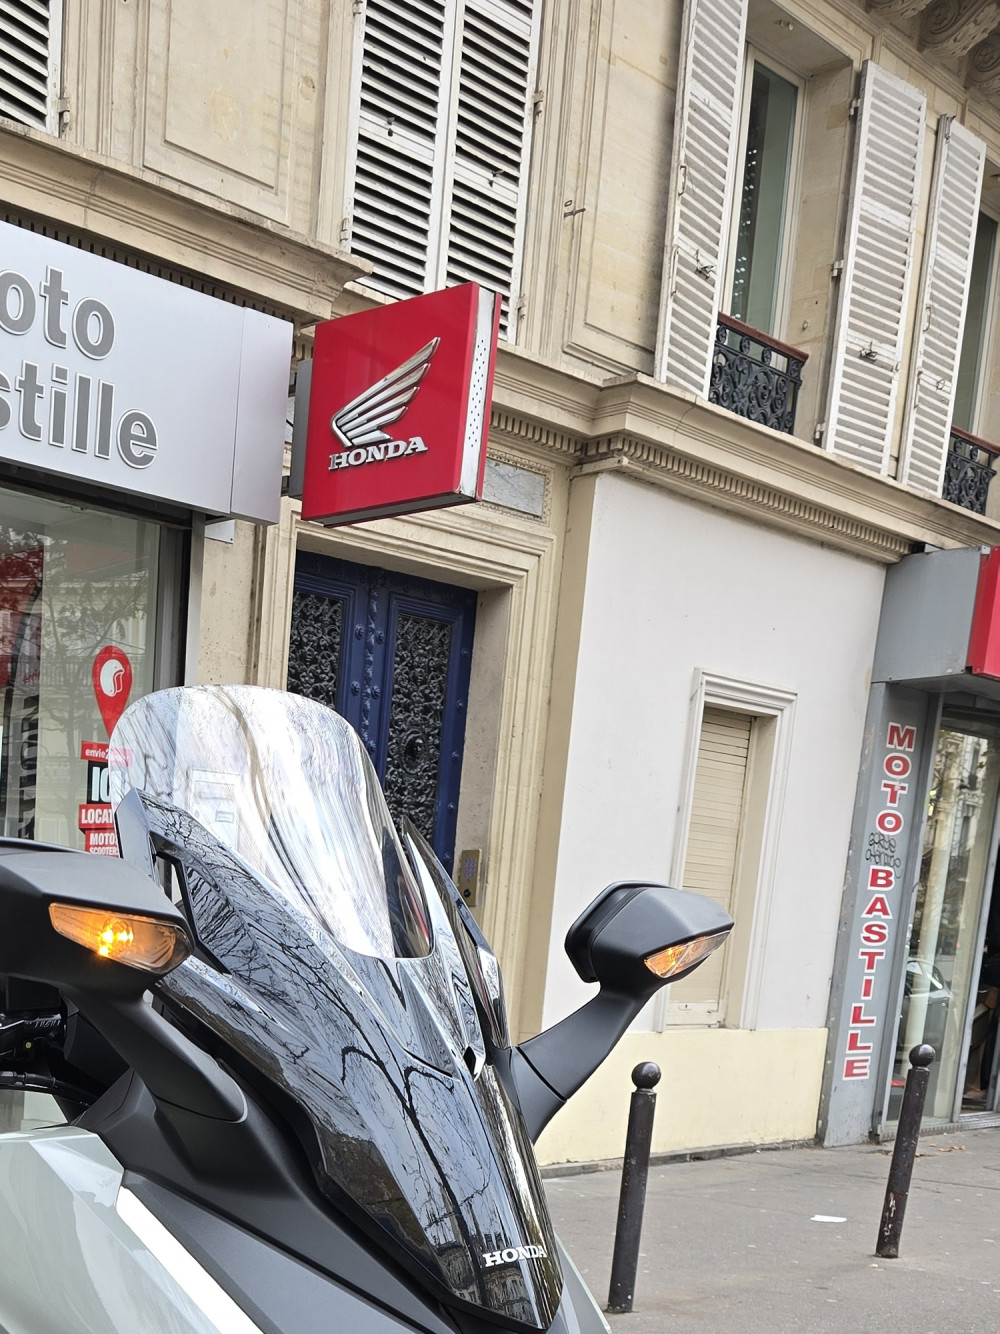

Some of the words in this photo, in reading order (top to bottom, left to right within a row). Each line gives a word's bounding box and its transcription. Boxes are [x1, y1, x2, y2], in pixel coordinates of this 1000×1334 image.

[328, 436, 428, 470] HONDA
[876, 721, 916, 837] MOTO
[842, 864, 896, 1082] BASTILLE
[482, 1245, 548, 1267] HONDA
